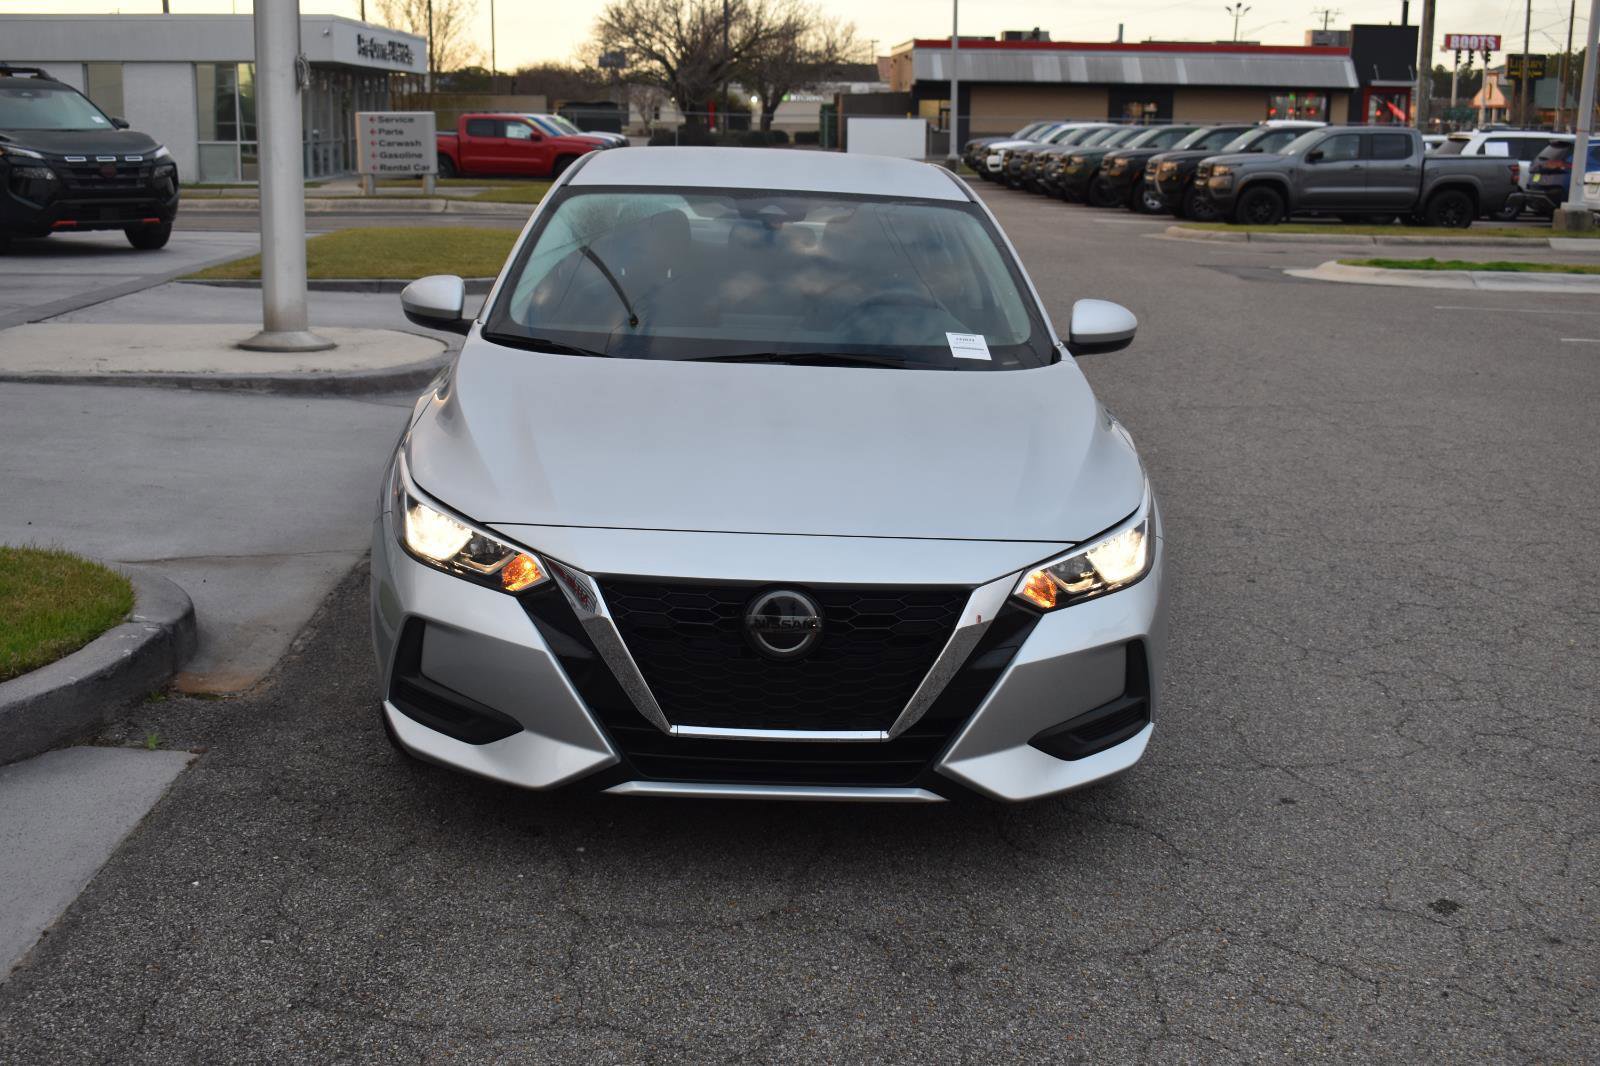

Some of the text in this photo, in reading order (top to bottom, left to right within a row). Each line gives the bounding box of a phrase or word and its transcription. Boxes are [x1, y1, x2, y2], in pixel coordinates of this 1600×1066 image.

[1450, 35, 1497, 49] BOOTS
[377, 115, 414, 124] Service
[378, 128, 404, 136] Parts
[378, 139, 422, 147] Carwash
[379, 151, 423, 159] Gasoline
[379, 163, 430, 172] Rental Car
[752, 618, 815, 633] NISSAN
